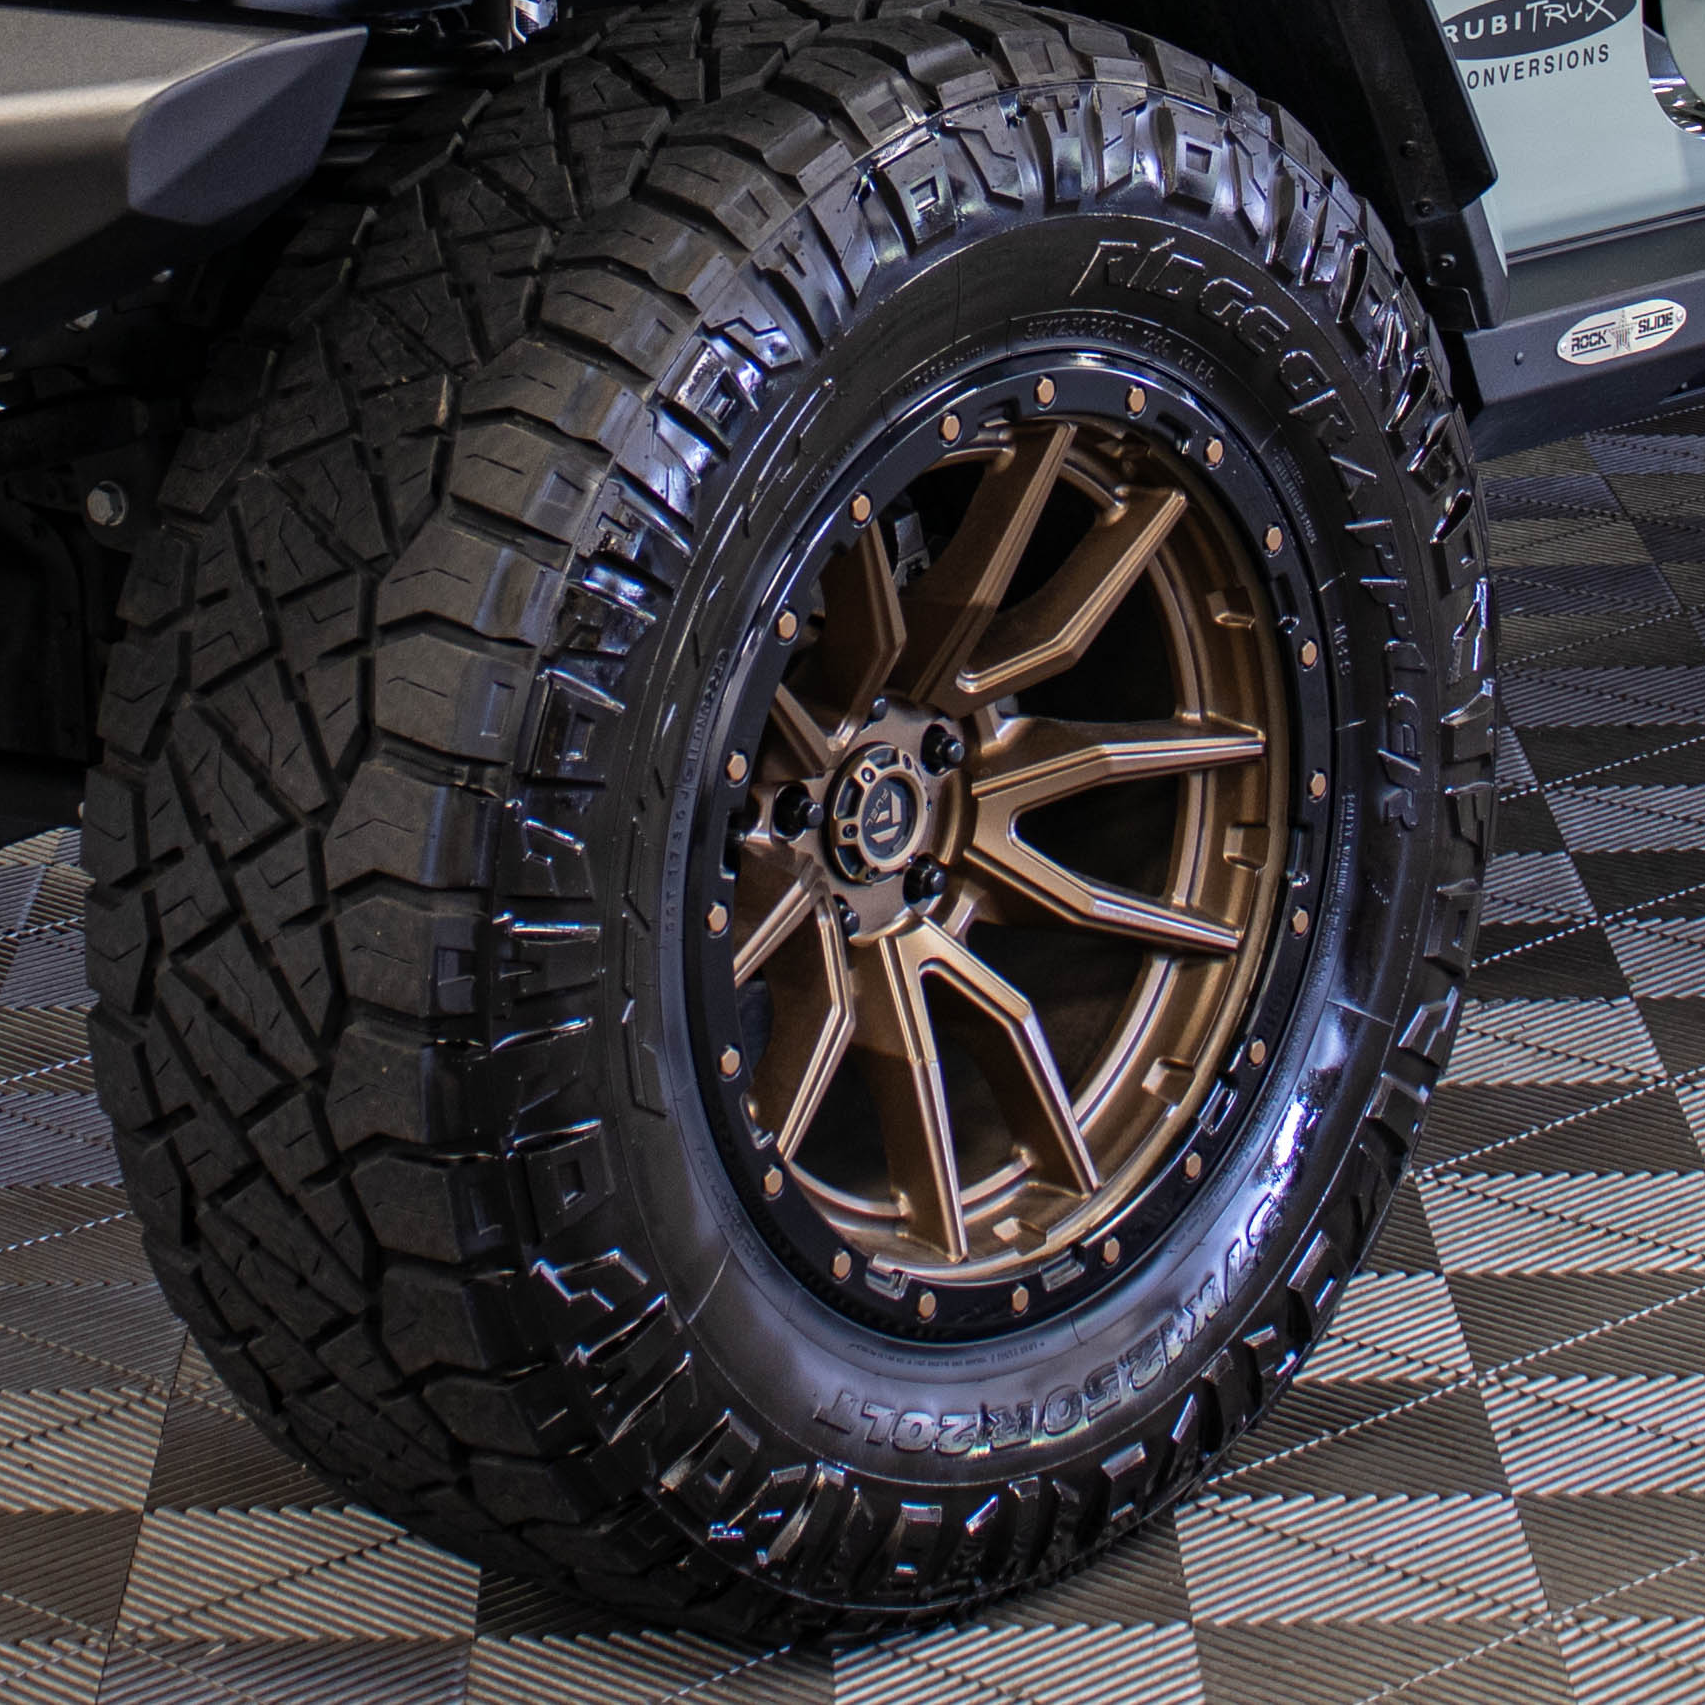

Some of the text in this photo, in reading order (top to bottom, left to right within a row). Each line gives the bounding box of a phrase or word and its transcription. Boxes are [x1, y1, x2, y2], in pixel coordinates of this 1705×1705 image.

[1467, 44, 1610, 90] ONVERSIONS
[1571, 311, 1674, 352] ROCK SLIDE
